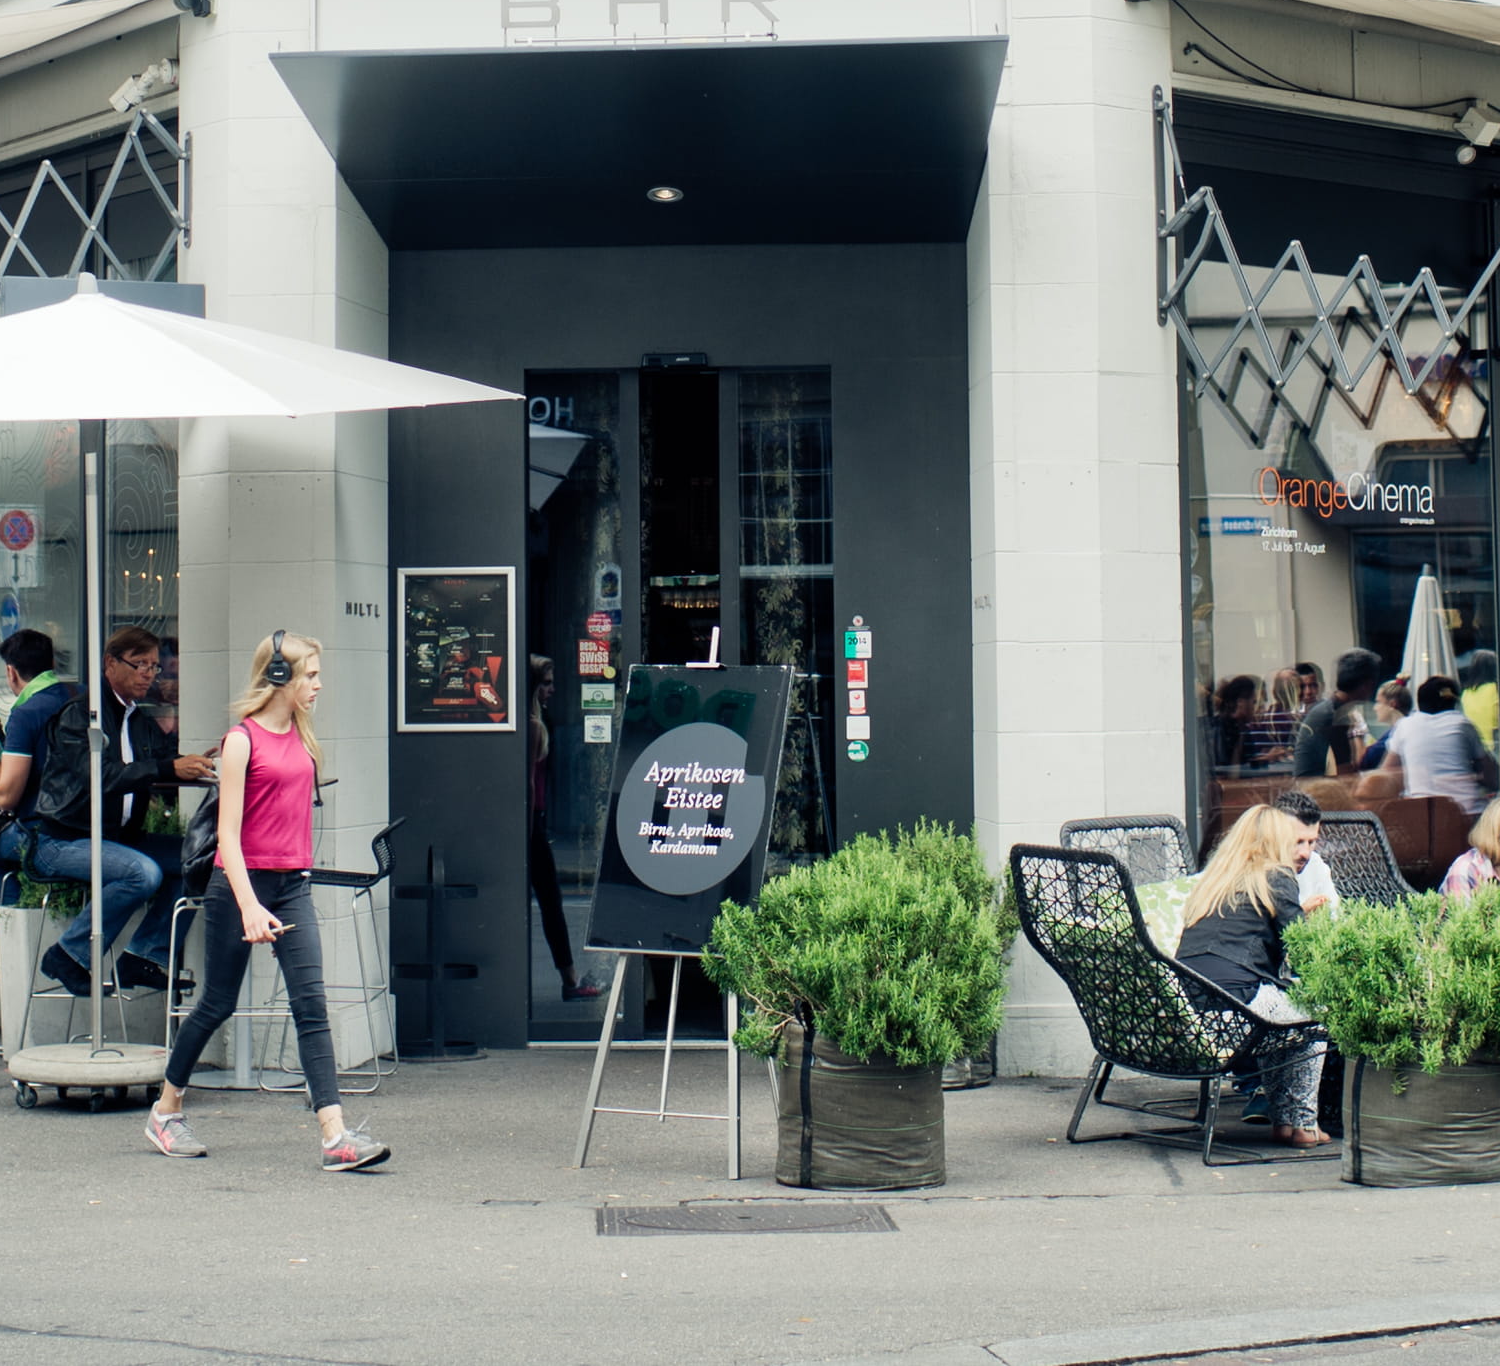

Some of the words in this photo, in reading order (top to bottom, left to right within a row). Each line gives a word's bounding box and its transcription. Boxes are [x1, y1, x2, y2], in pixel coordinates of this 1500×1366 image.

[1258, 466, 1435, 518] OrangeCinema
[346, 601, 380, 618] HILTL
[643, 760, 745, 787] Aprikosen
[663, 786, 723, 809] Eistee
[638, 821, 675, 838] Birne,
[677, 822, 734, 840] Aprikose,
[650, 839, 718, 855] Kardamom
